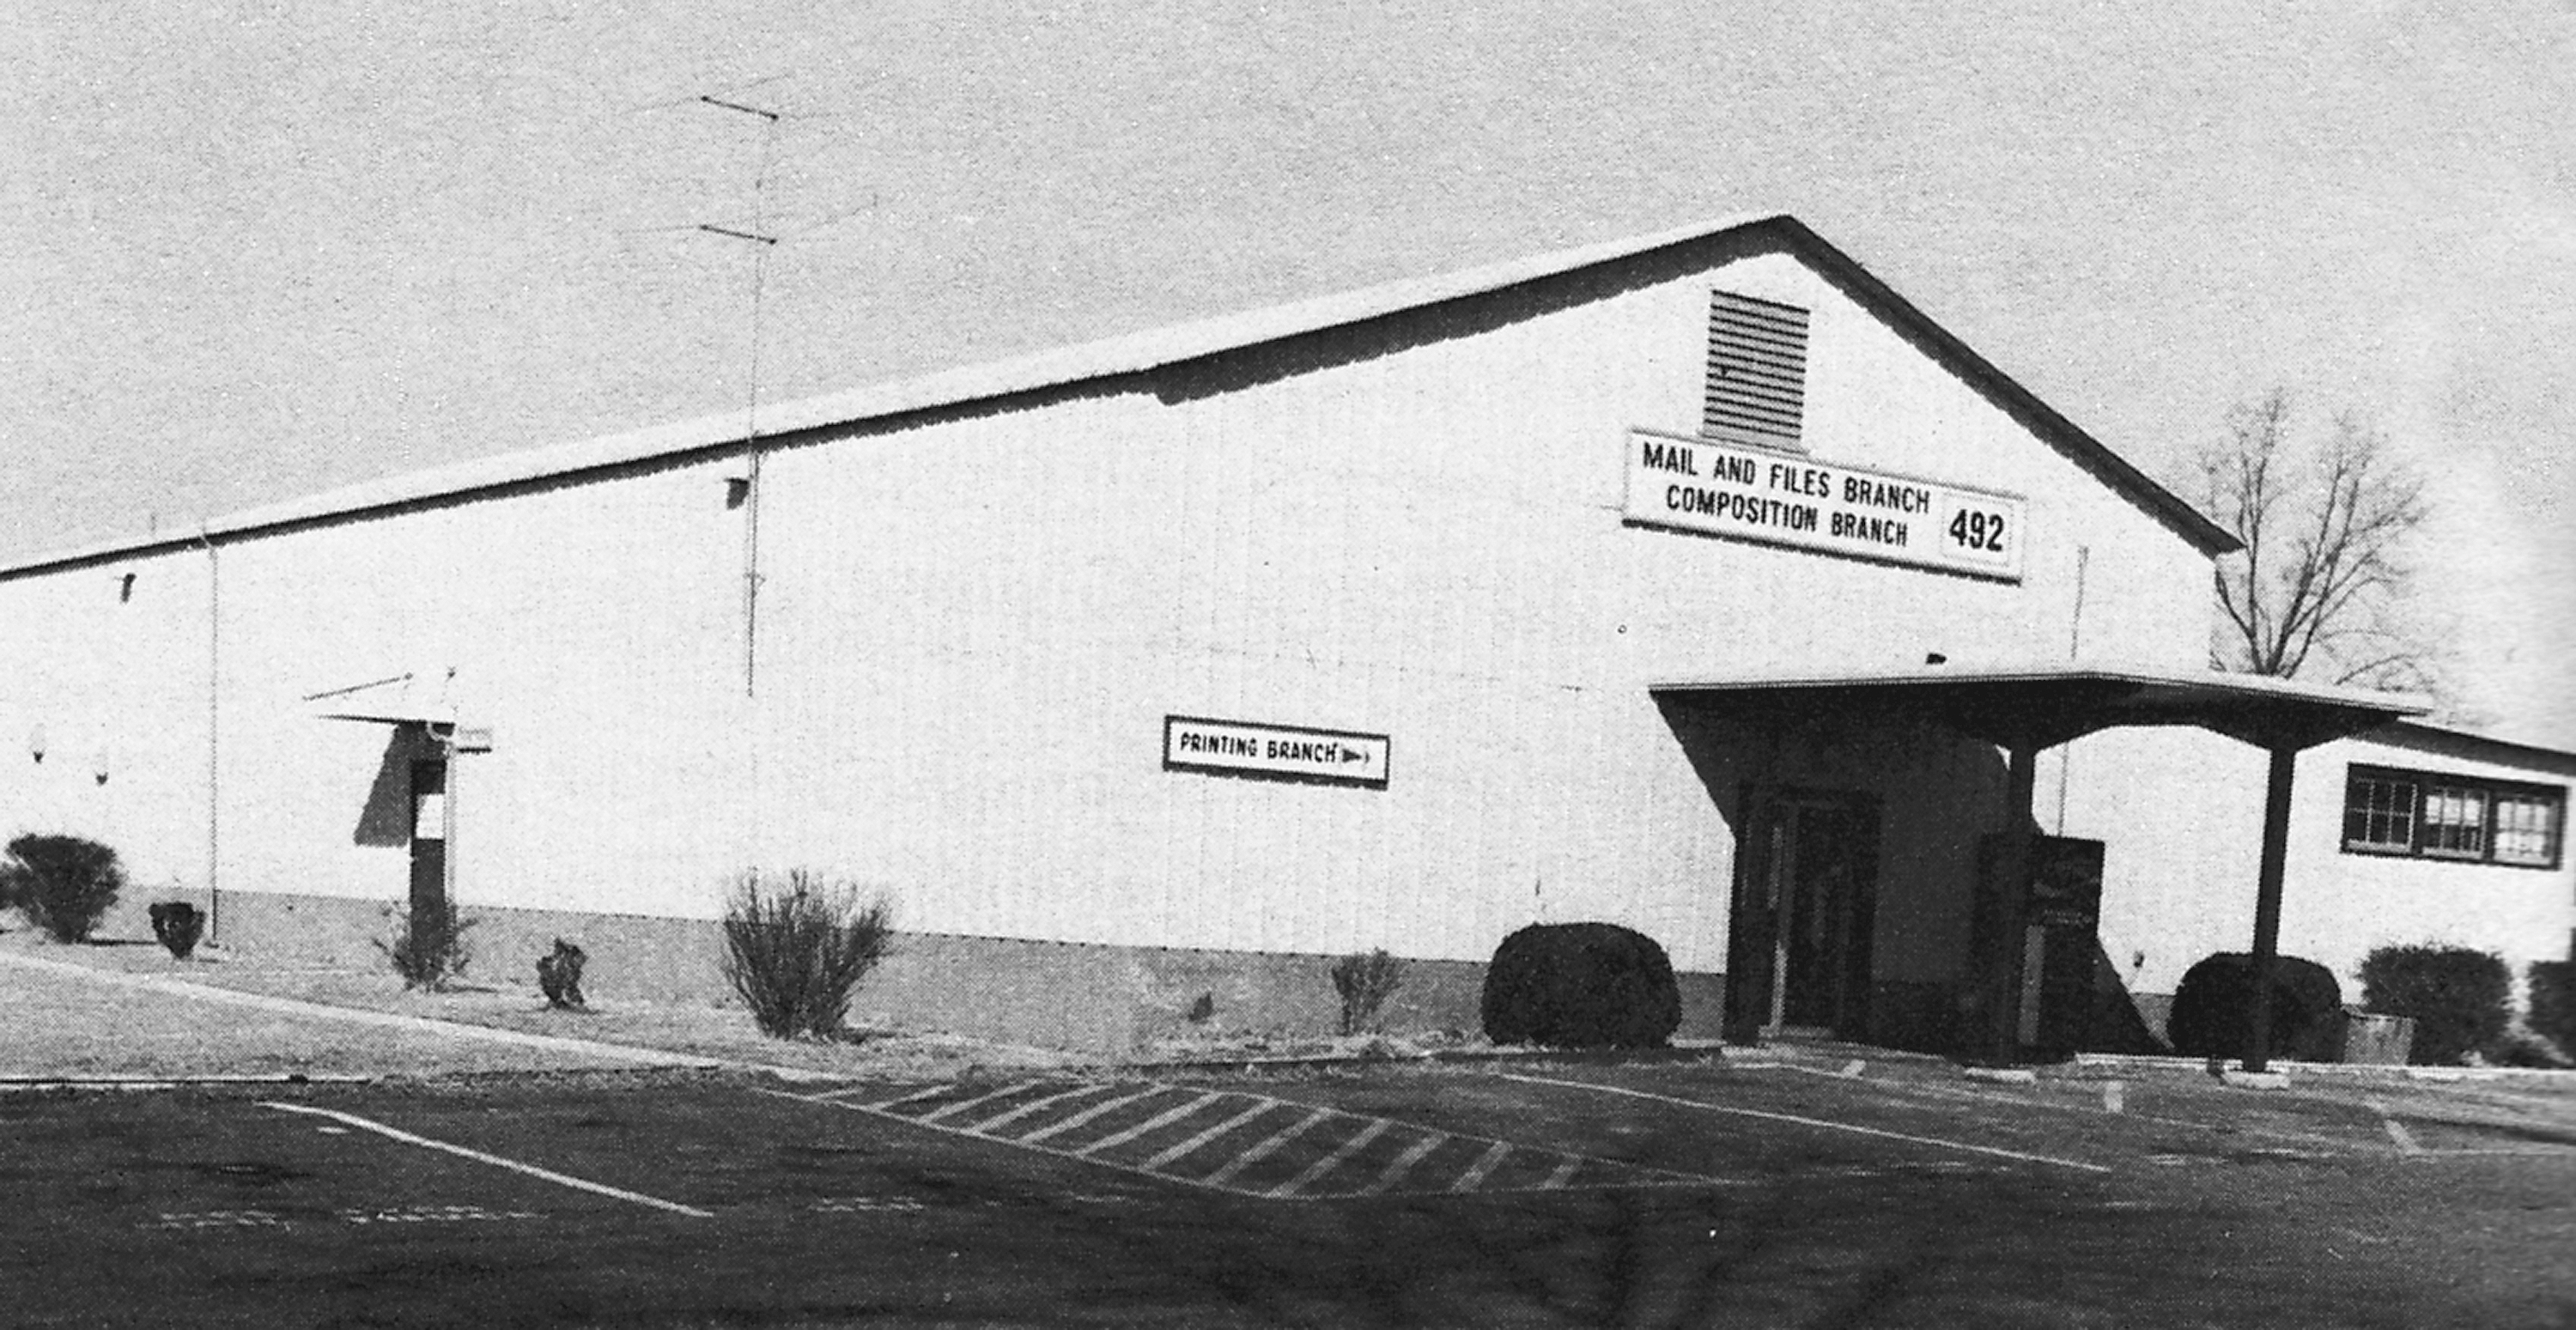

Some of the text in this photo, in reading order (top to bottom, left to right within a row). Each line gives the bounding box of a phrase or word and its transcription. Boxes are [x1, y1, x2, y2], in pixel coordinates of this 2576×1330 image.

[1643, 442, 1929, 513] MAIL AND FILES BRANCH
[1667, 484, 1908, 547] COMPOSITION BRANCH
[1949, 508, 2006, 552] 492
[1180, 732, 1337, 762] PRINTING BRANCH
